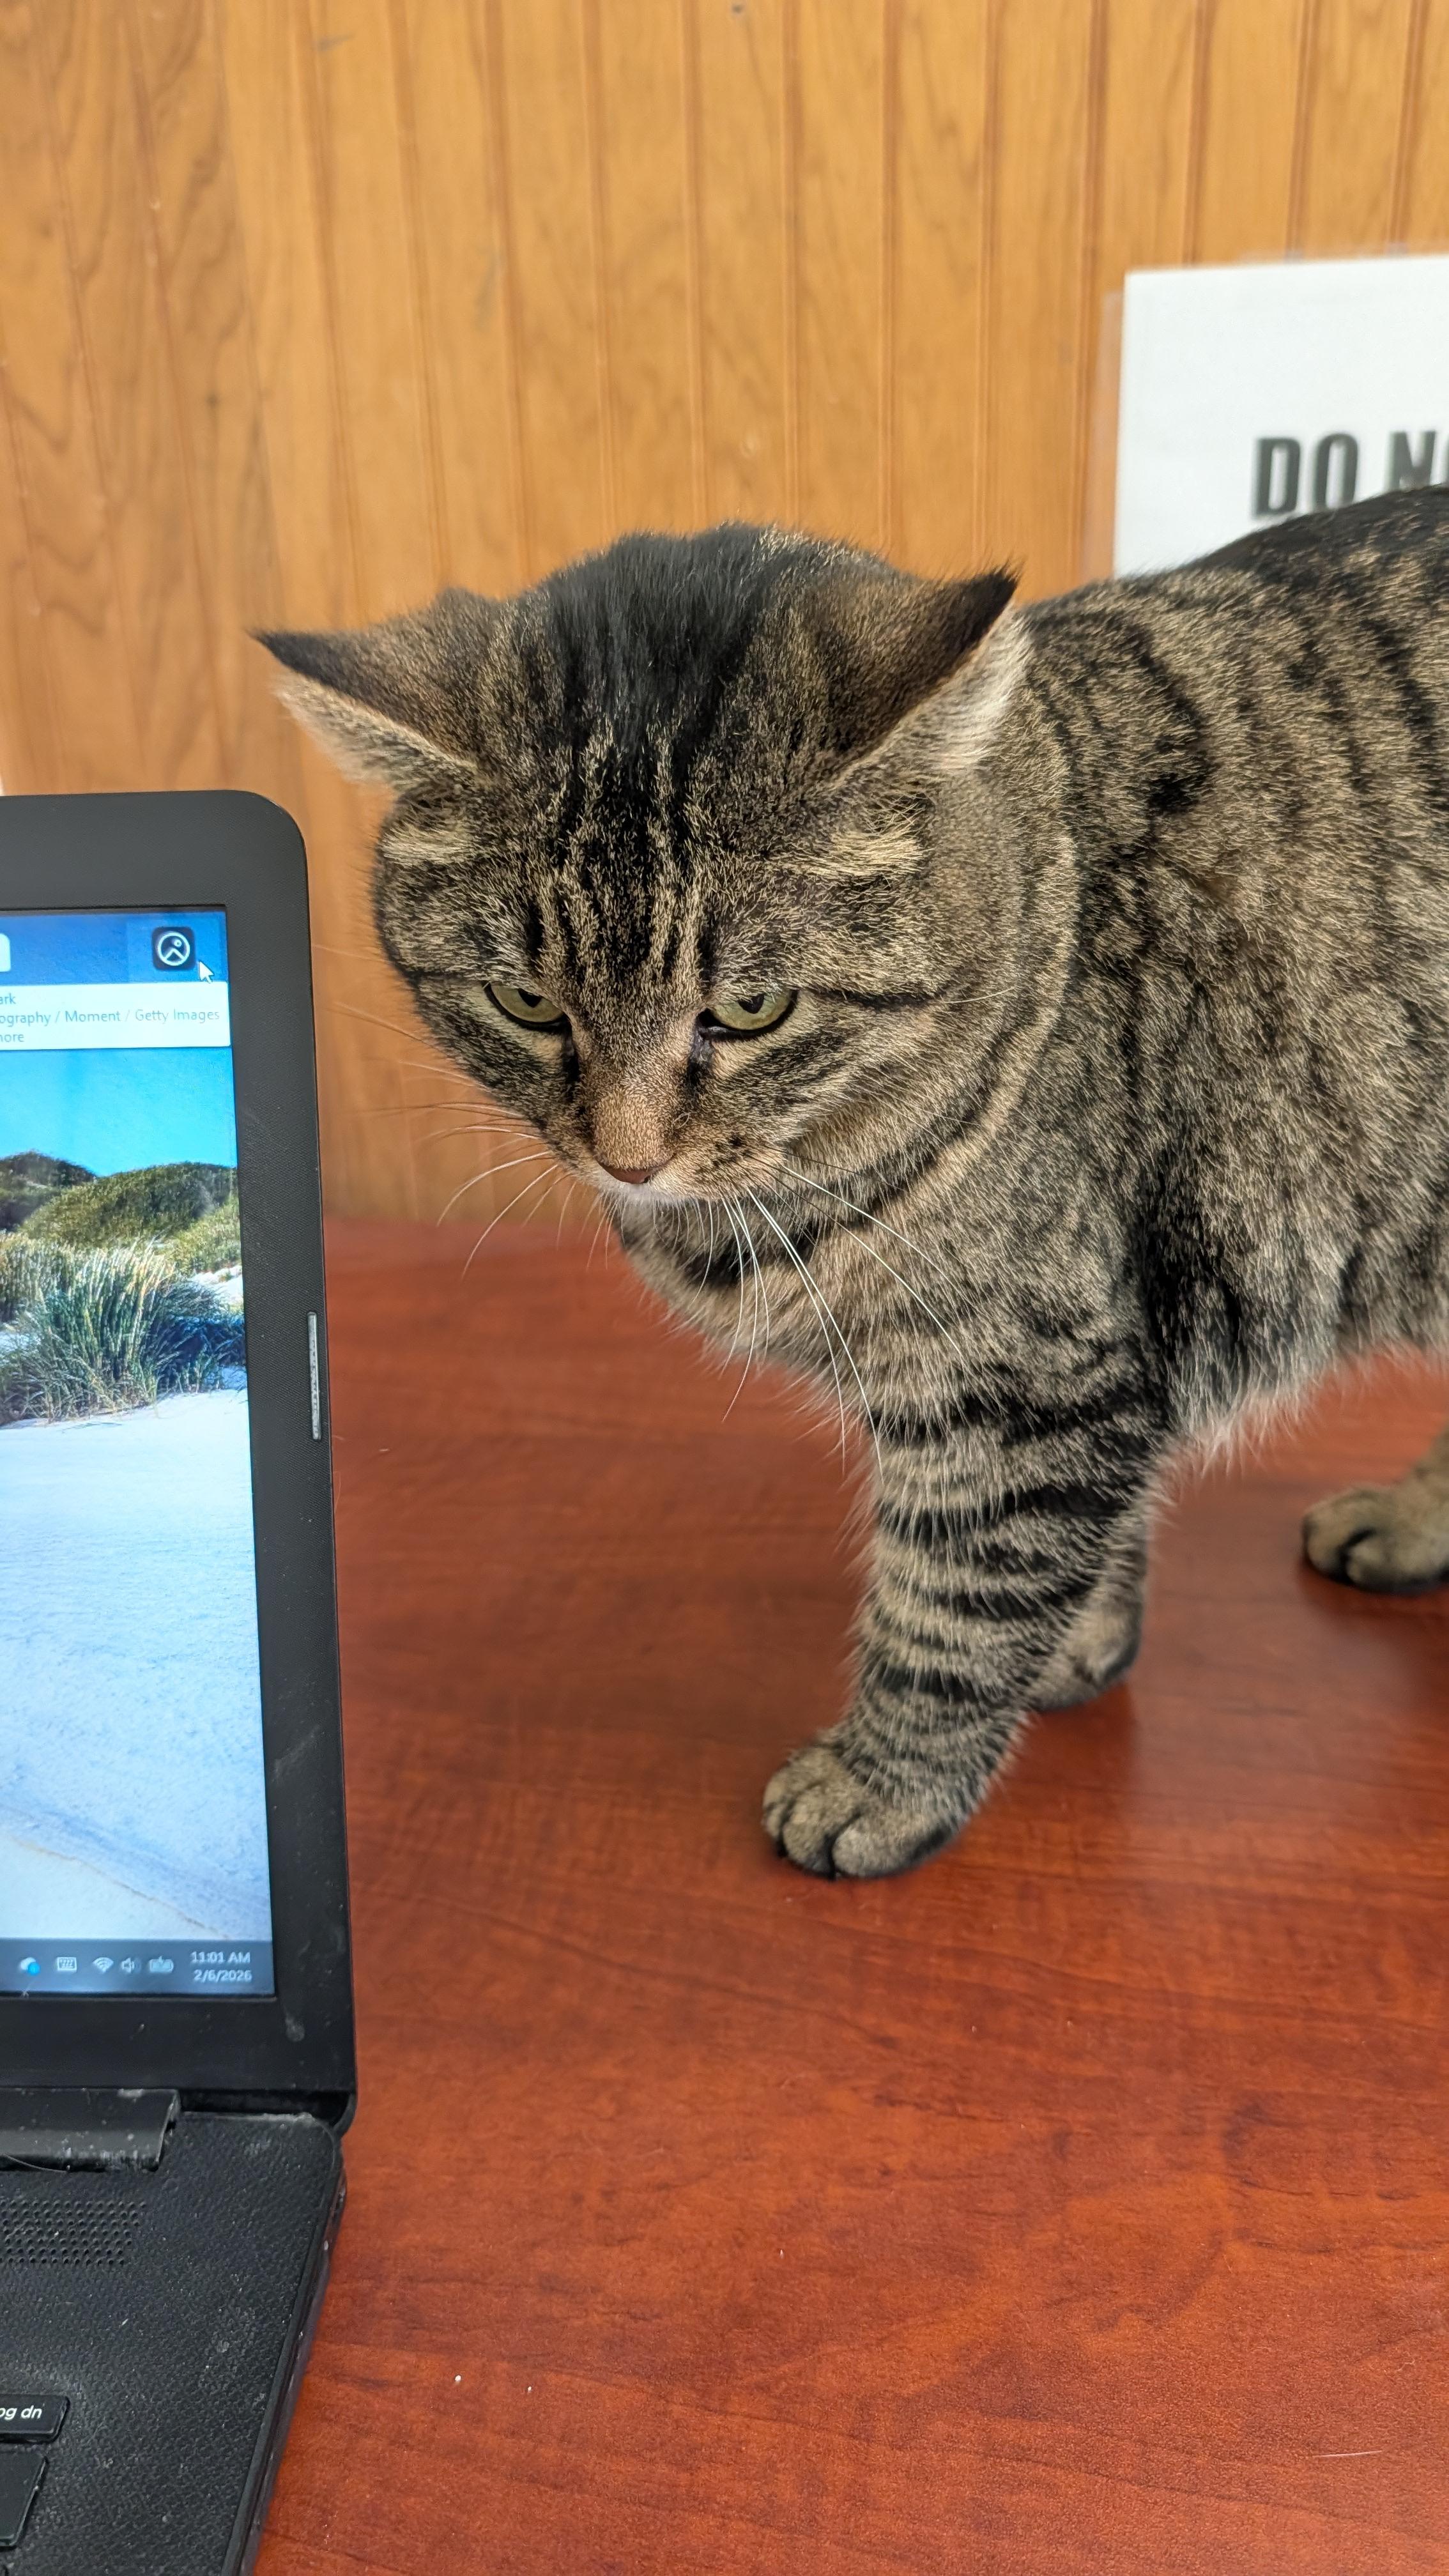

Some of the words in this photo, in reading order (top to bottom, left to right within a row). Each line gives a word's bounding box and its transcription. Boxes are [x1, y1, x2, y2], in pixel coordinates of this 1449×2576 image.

[1252, 433, 1359, 517] DO
[1385, 429, 1449, 491] N
[65, 1010, 121, 1022] Moment
[135, 1009, 169, 1024] Getty
[173, 1009, 220, 1023] Images
[191, 1951, 224, 1963] 11:01
[227, 1951, 250, 1963] AM
[194, 1969, 252, 1983] 2/6/2026
[20, 2405, 42, 2419] dn
